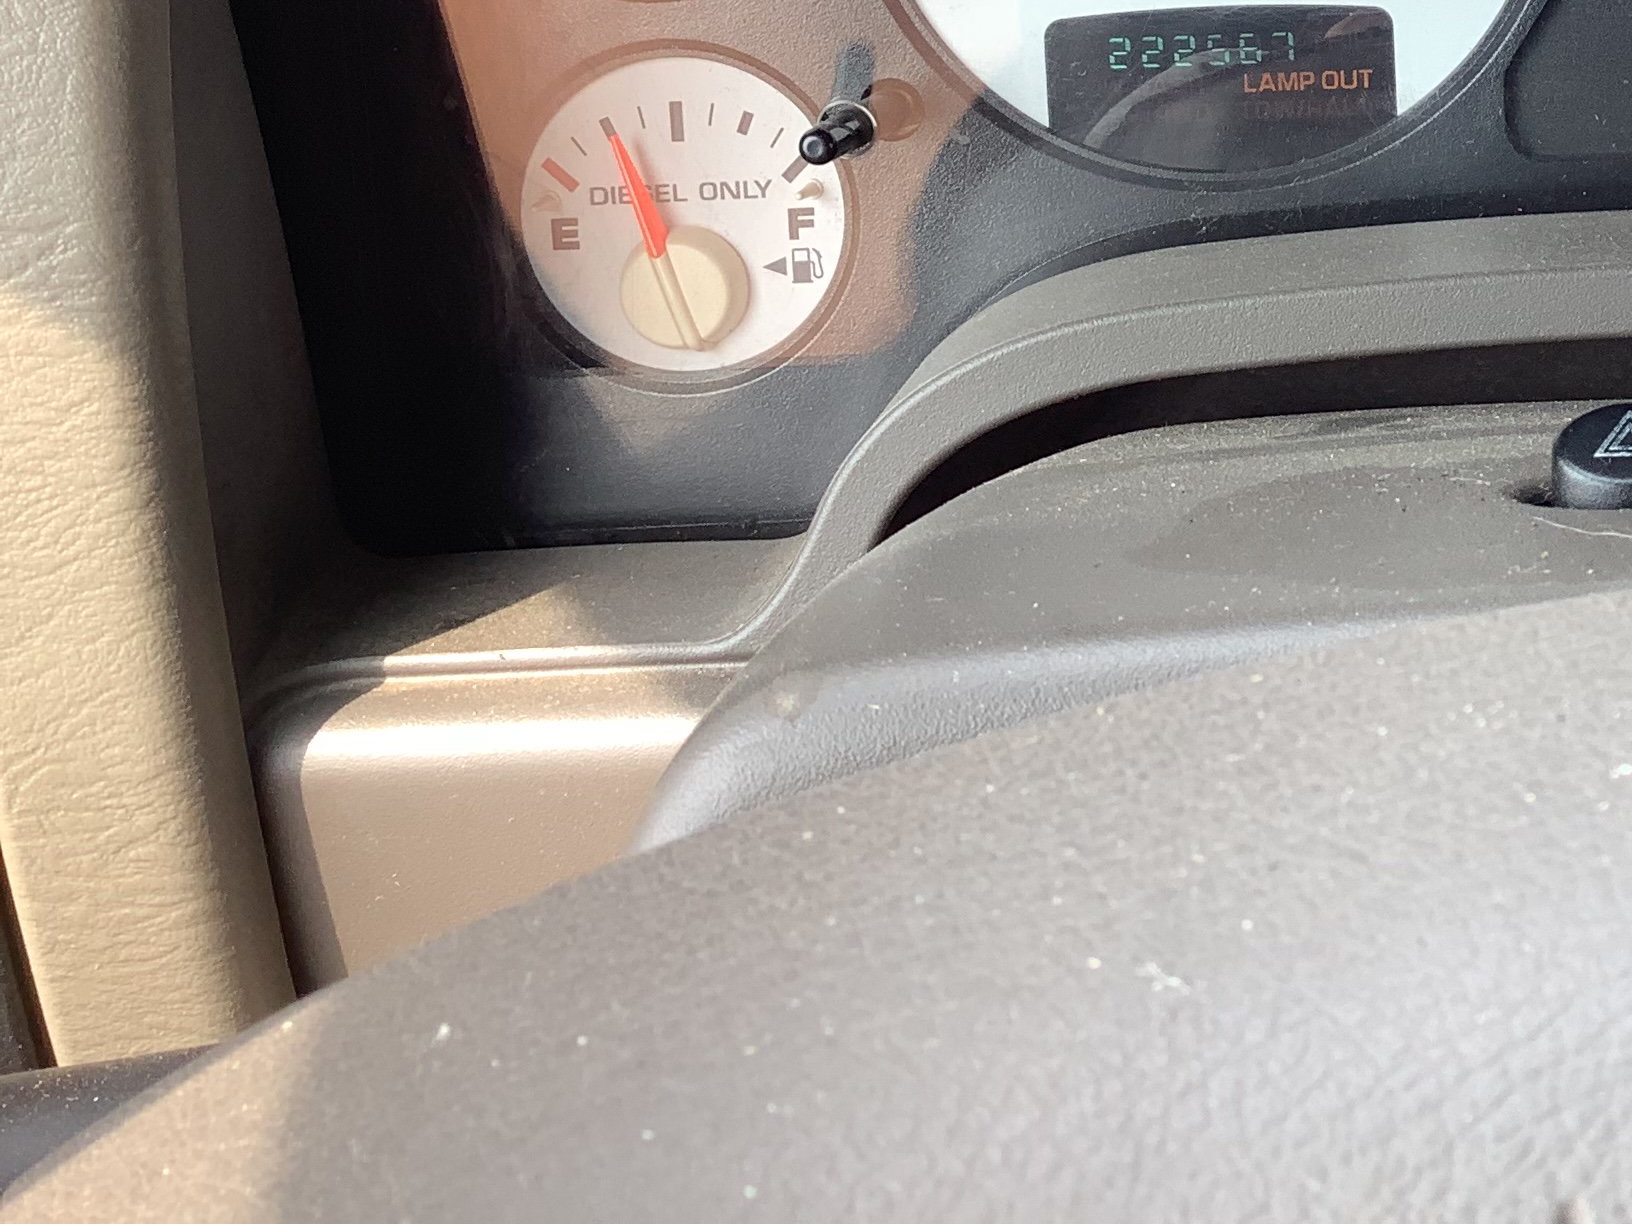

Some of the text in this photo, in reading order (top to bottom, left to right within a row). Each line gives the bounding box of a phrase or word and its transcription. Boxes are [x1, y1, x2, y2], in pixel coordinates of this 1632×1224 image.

[1108, 31, 1296, 70] 222567
[1244, 69, 1371, 93] LAMP OUT
[588, 179, 773, 207] DIEEL ONLY
[550, 217, 581, 252] E
[787, 206, 815, 241] F
